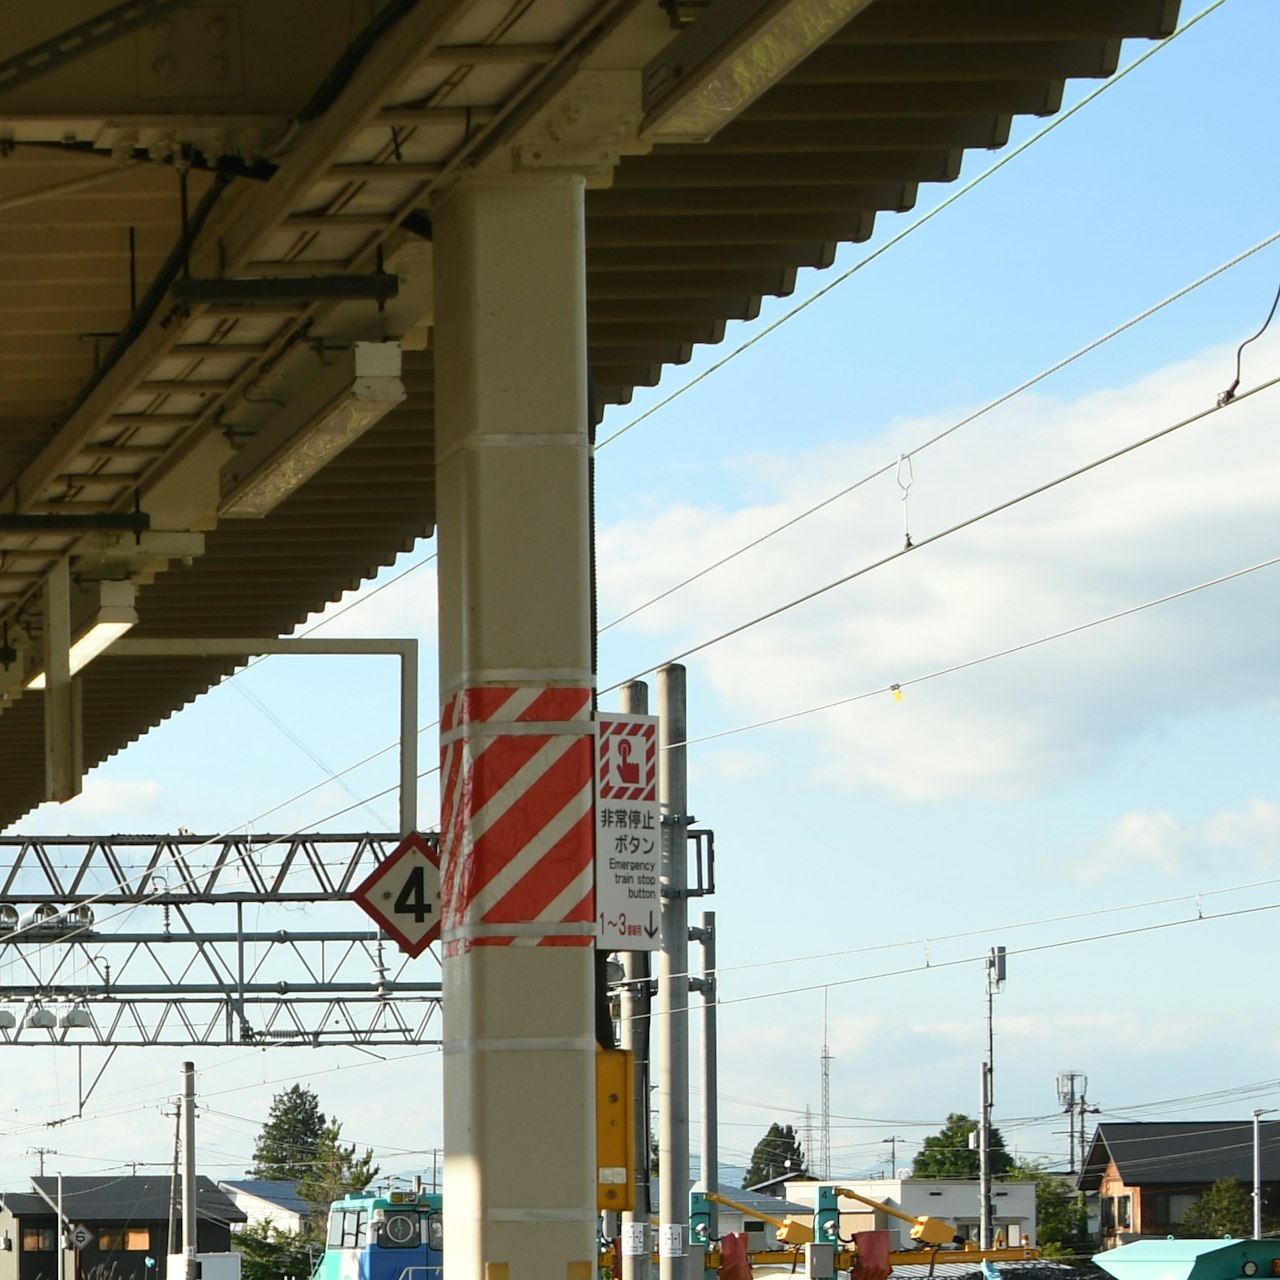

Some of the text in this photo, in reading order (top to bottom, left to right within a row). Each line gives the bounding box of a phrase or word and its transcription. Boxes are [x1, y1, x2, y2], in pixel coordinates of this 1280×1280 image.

[601, 808, 655, 832] 非常停止
[614, 836, 655, 855] ボタン
[609, 857, 656, 873] Emergency
[615, 872, 656, 887] train stop
[394, 866, 432, 923] 4
[628, 886, 656, 899] button
